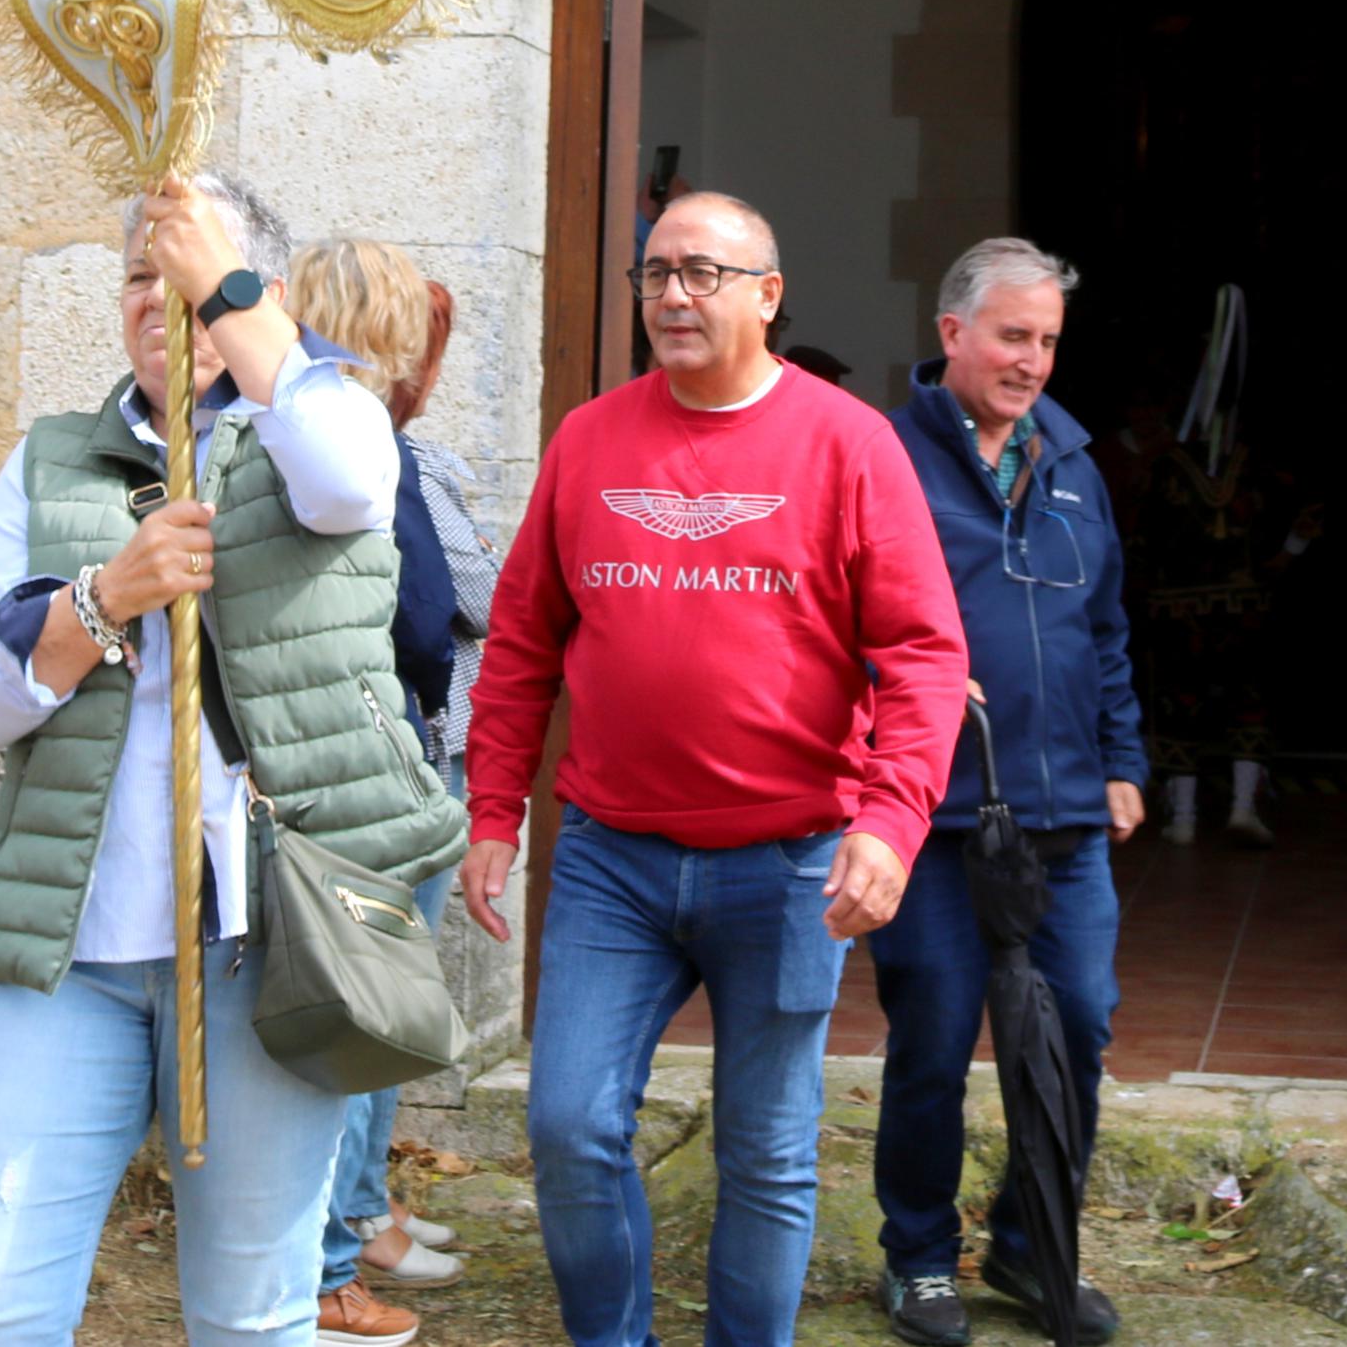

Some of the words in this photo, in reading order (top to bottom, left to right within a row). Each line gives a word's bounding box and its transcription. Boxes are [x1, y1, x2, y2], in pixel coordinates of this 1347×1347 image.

[652, 499, 686, 511] ASTON
[688, 501, 725, 513] MARTIN
[581, 562, 662, 589] ASTON
[673, 566, 798, 596] MARTIN
